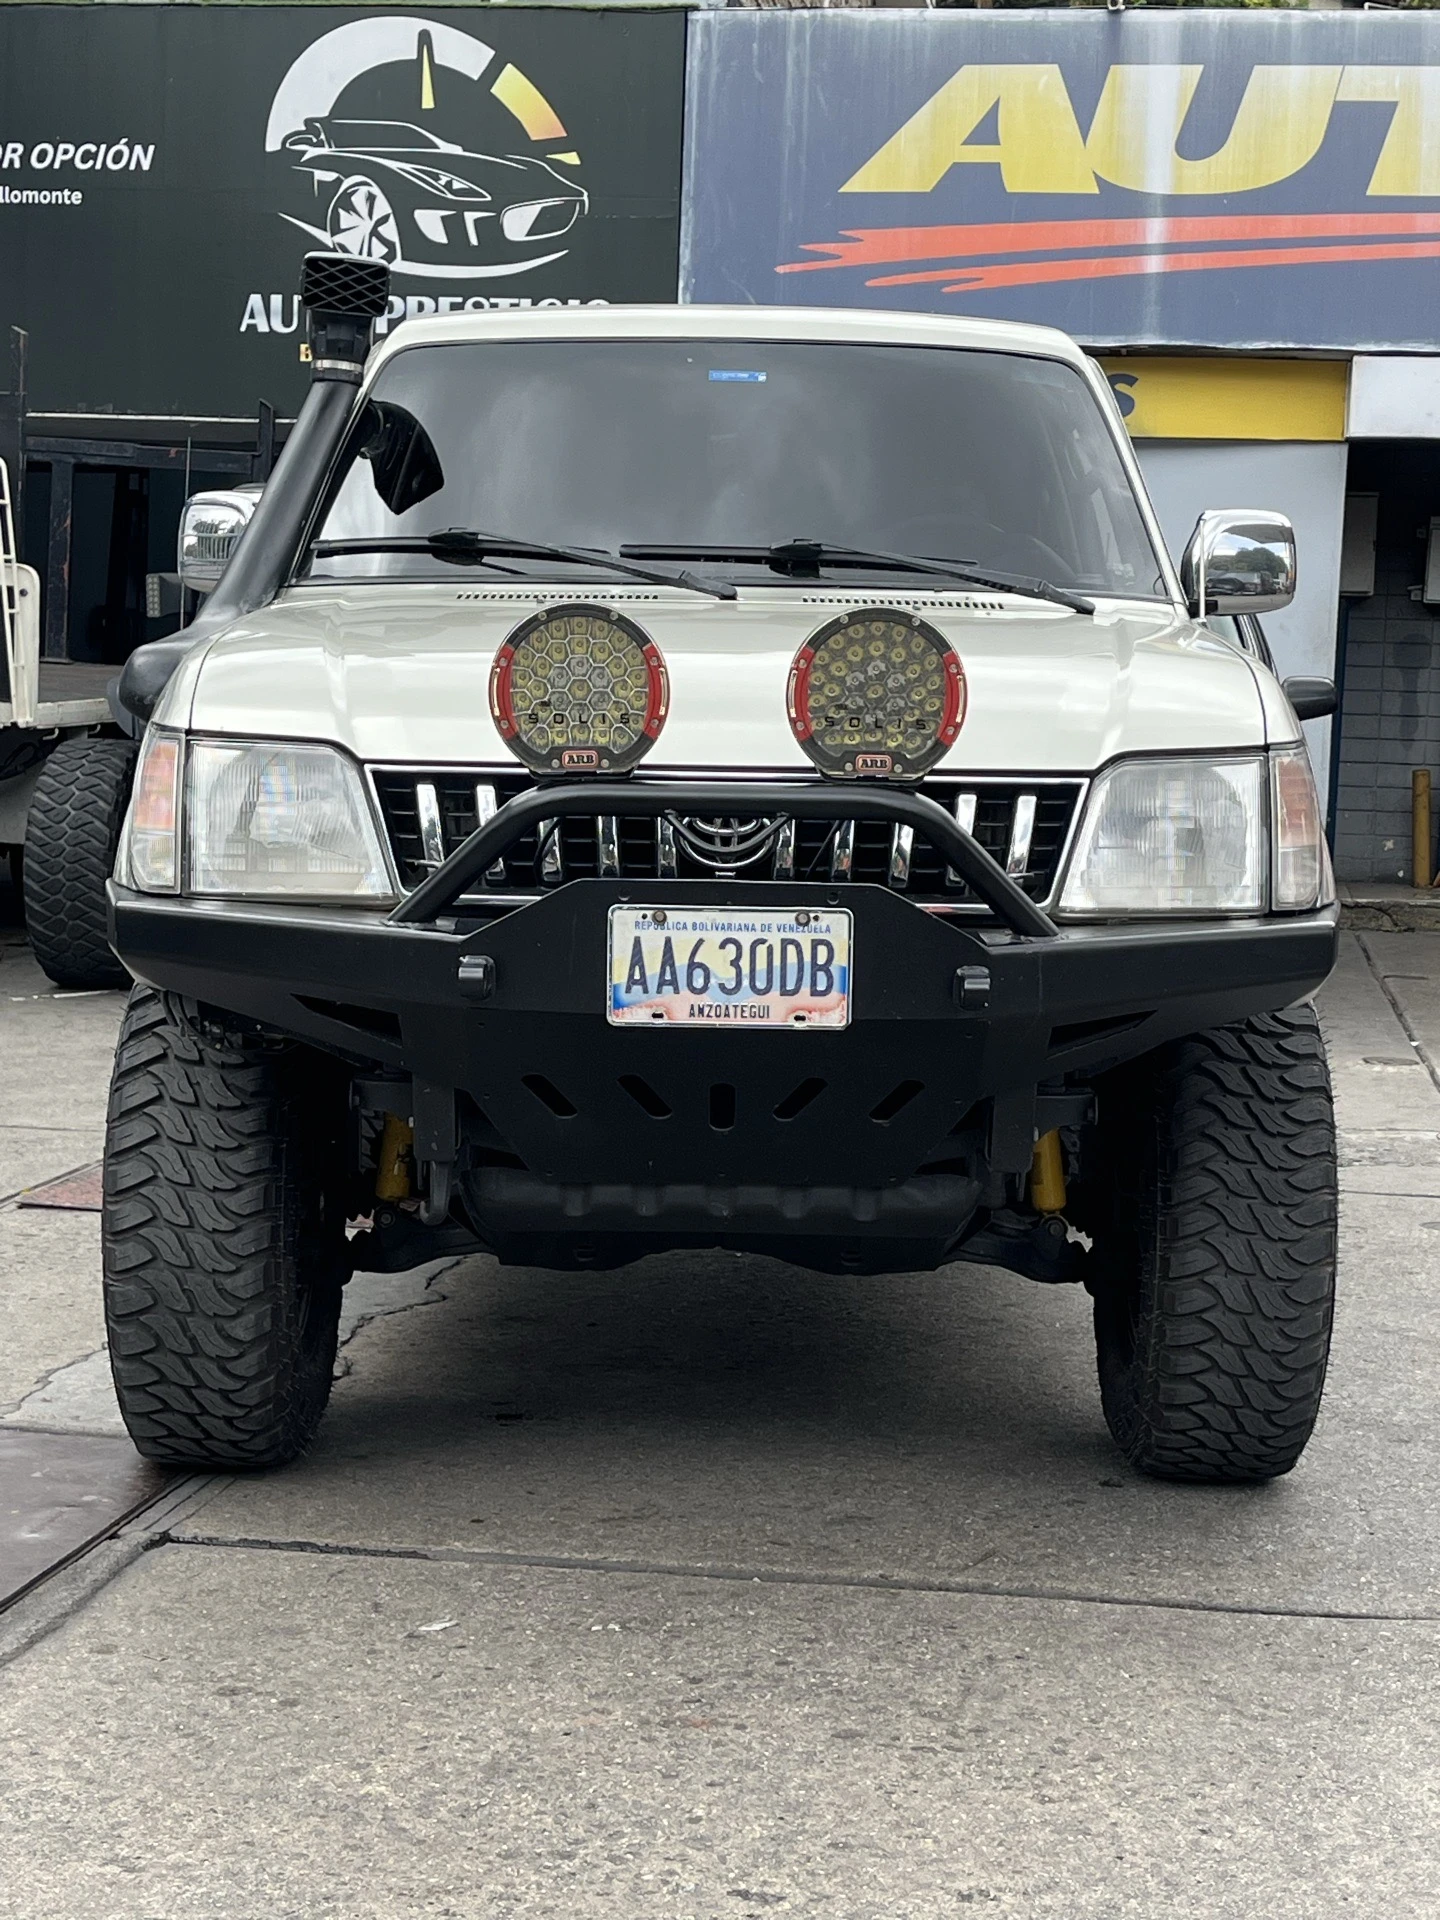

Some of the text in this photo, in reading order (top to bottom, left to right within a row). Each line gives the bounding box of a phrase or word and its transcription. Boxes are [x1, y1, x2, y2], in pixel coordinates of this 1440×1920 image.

[0, 138, 155, 171] R OPCIÓN
[529, 713, 629, 724] SOLIS
[825, 716, 926, 730] SOLIS
[566, 754, 595, 764] ARB
[860, 758, 888, 769] ARB
[691, 922, 756, 933] BOLIVARIANA
[760, 923, 772, 933] DE
[776, 923, 831, 934] VENEZUELA
[625, 936, 835, 997] AA630DB
[689, 1003, 770, 1019] ANZOATEGUI
